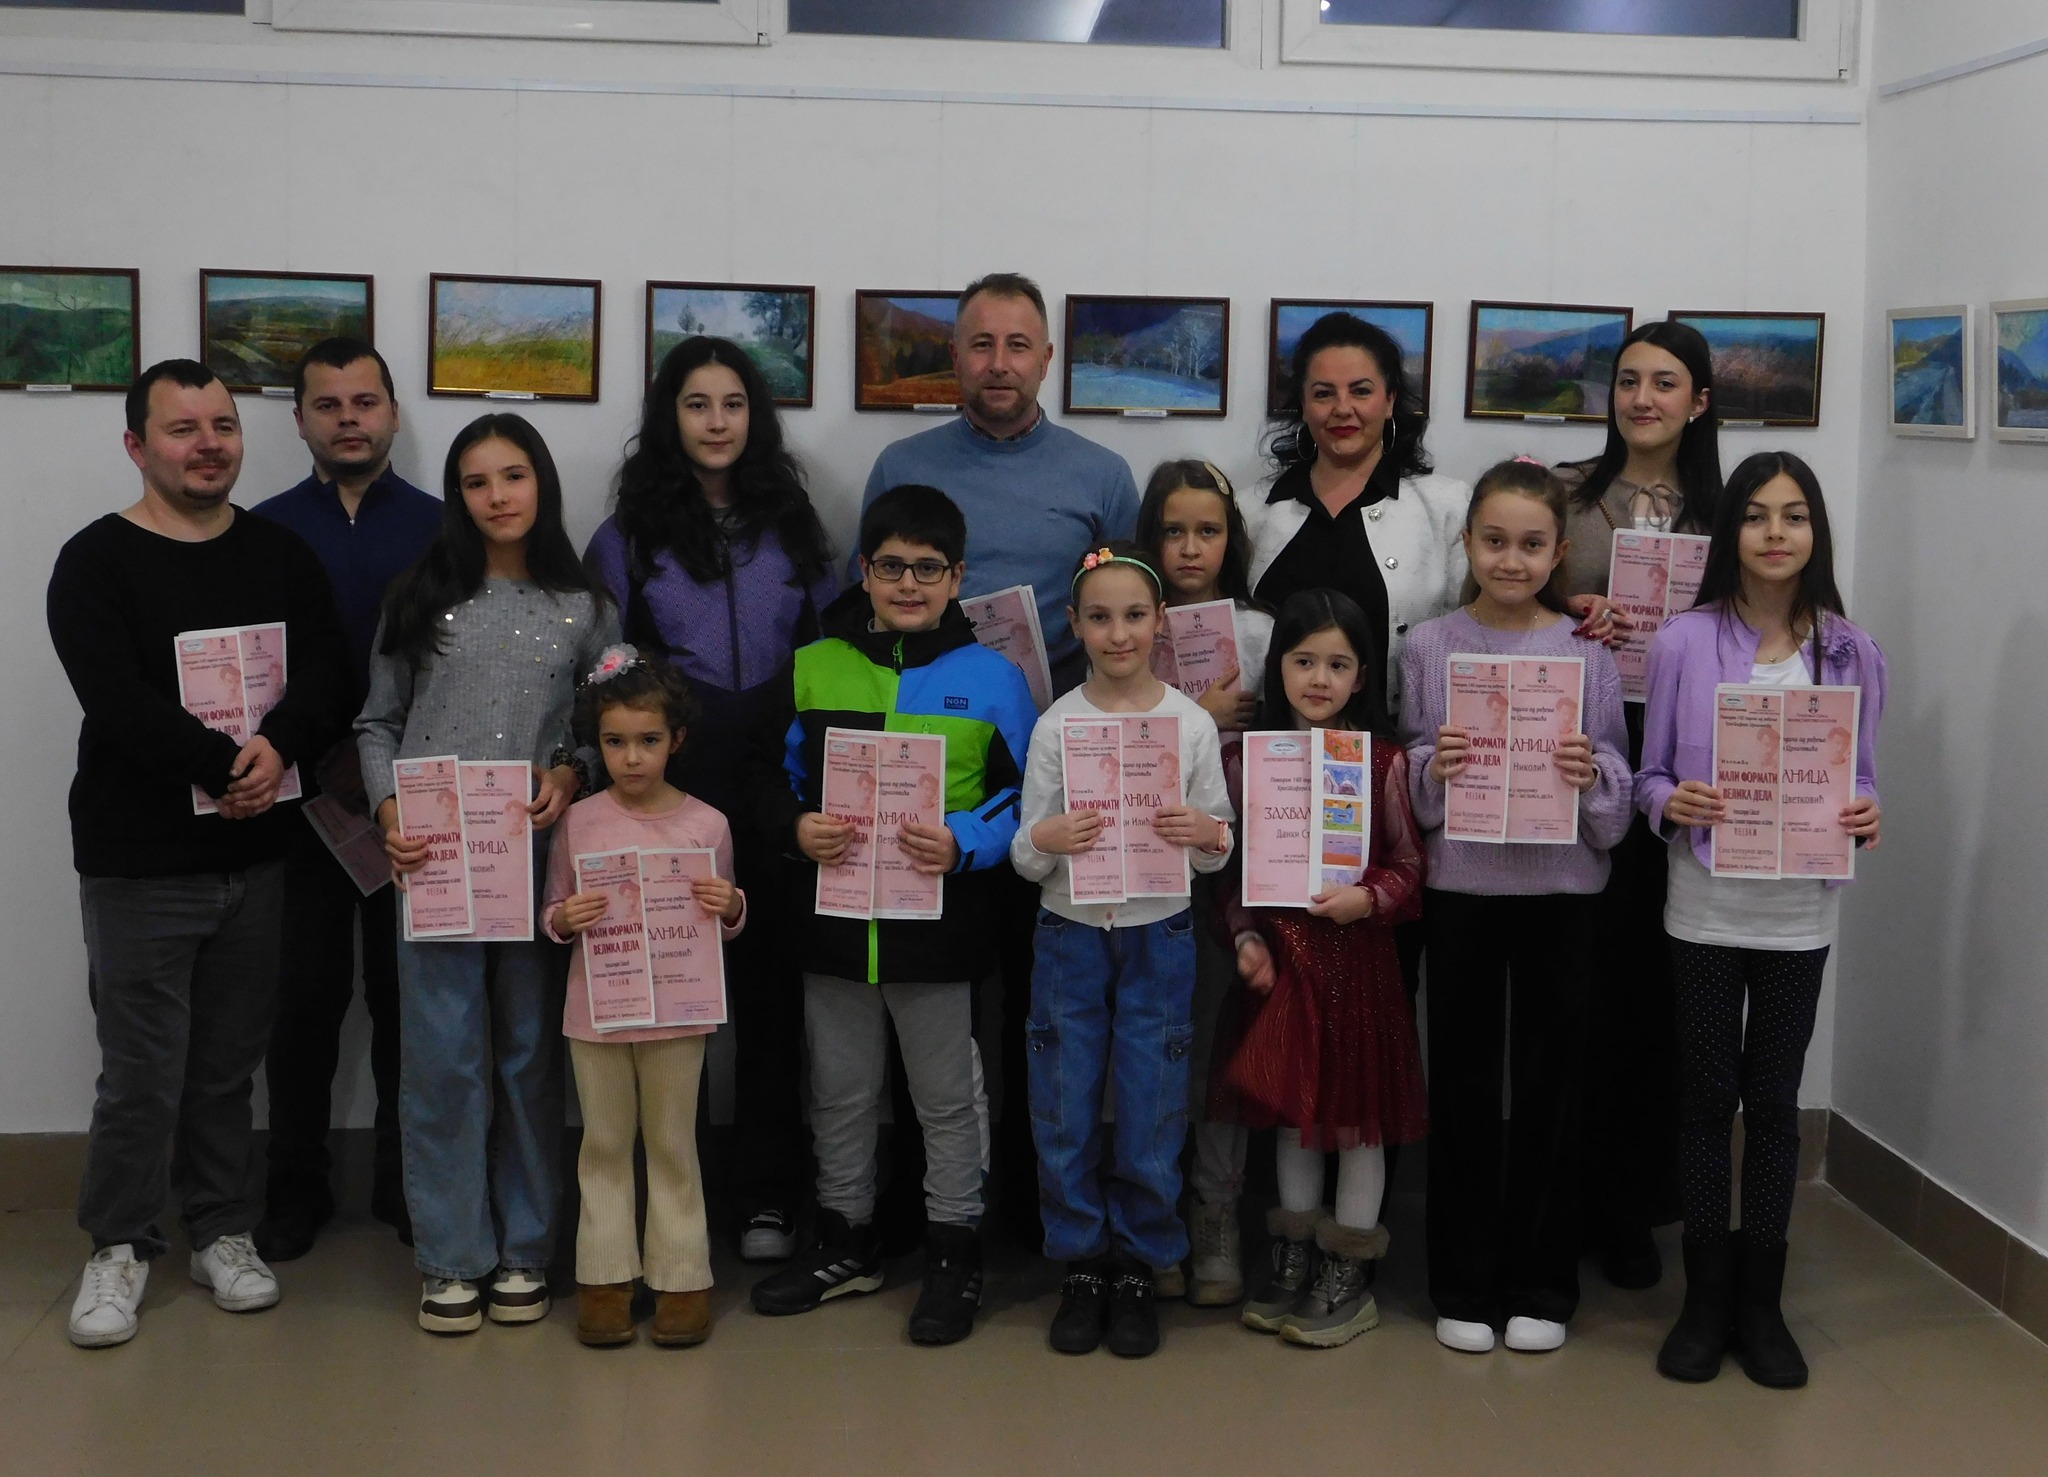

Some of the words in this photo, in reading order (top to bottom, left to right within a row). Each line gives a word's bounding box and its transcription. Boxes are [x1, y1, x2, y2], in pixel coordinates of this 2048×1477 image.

[1631, 604, 1664, 617] ФОРМАТИ
[209, 707, 244, 721] ФОРМАТИ
[1472, 736, 1507, 750] ФОРМАТИ
[1482, 754, 1502, 768] ДЕЛА
[1513, 761, 1547, 772] Николић
[1718, 770, 1740, 782] МАЛИ
[1741, 771, 1778, 784] ФОРМАТИ
[1722, 787, 1752, 800] ВЕЛИКА
[1752, 789, 1773, 802] ДЕЛА
[1782, 794, 1825, 804] Цветковић
[1070, 799, 1087, 811] МАЛИ
[1088, 799, 1120, 811] ФОРМАТИ
[843, 814, 874, 828] ФОРМАТИ
[1132, 817, 1150, 827] Илић
[426, 831, 461, 845] ФОРМАТИ
[1276, 828, 1300, 840] Данки
[440, 848, 458, 863] ДЕЛА
[587, 926, 607, 939] МАЛИ
[608, 922, 643, 936] ФОРМАТИ
[593, 942, 621, 956] ВЕЛИКА
[622, 939, 641, 954] ДЕЛА
